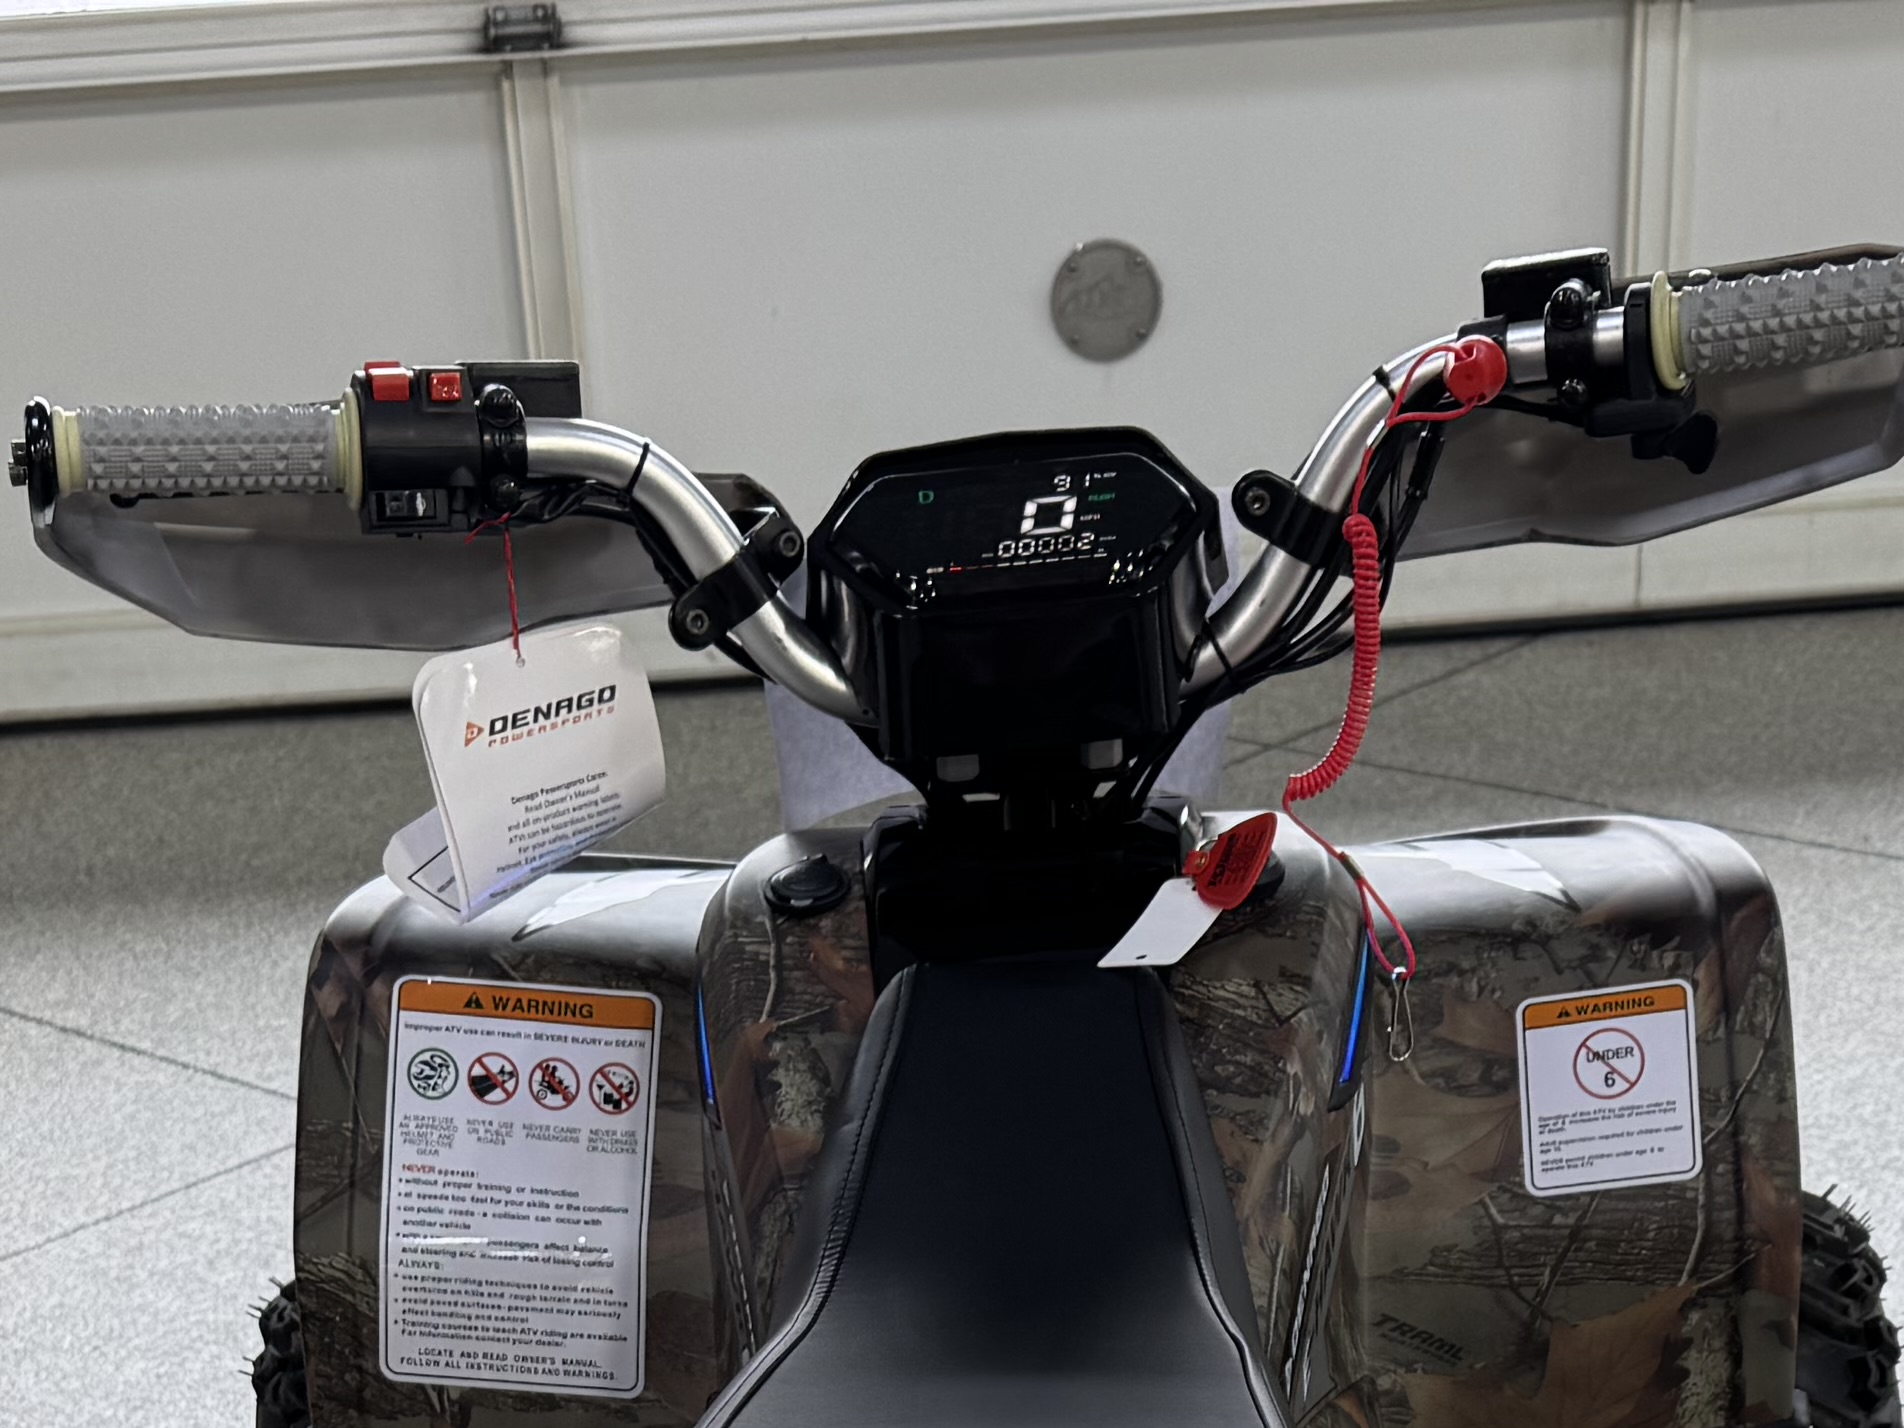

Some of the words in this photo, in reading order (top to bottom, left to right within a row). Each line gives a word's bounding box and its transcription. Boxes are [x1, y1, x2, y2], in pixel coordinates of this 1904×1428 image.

[998, 532, 1095, 558] 00002
[488, 684, 616, 737] DENAGO
[488, 705, 615, 747] POWERSPORTS
[511, 791, 539, 805] Denago
[540, 778, 584, 796] Powersports
[492, 995, 594, 1019] WARNING
[1576, 996, 1655, 1016] WARNING
[404, 1022, 442, 1033] Improper
[498, 1031, 522, 1039] result
[524, 1032, 531, 1040] in
[534, 1032, 567, 1043] SEVERE
[571, 1036, 603, 1046] INJURY
[615, 1040, 645, 1048] DEATH
[1586, 1046, 1634, 1063] UNDER
[1604, 1071, 1616, 1088] 6
[522, 1123, 550, 1132] NEVER
[402, 1164, 436, 1174] NEVER
[405, 1178, 438, 1186] without
[442, 1181, 473, 1189] proper
[477, 1183, 512, 1194] training
[516, 1186, 526, 1194] or
[530, 1186, 579, 1197] instruction
[504, 1199, 524, 1207] your
[583, 1205, 629, 1214] conditions
[555, 1217, 581, 1225] occur
[420, 1248, 456, 1258] steering
[582, 1260, 614, 1268] control
[552, 1284, 578, 1292] avoid
[509, 1293, 536, 1302] rough
[539, 1295, 571, 1303] terrain
[556, 1308, 575, 1316] may
[577, 1310, 621, 1320] seriously
[402, 1318, 439, 1330] Training
[540, 1329, 568, 1340] riding
[512, 1338, 533, 1346] your
[418, 1347, 453, 1358] LOCATE
[460, 1350, 479, 1360] AND
[482, 1352, 508, 1362] READ
[514, 1354, 556, 1365] OWNER'S
[400, 1357, 440, 1367] FOLLOW
[444, 1360, 461, 1369] ALL
[465, 1362, 539, 1375] INSTRUCTIONS
[541, 1368, 560, 1376] AND
